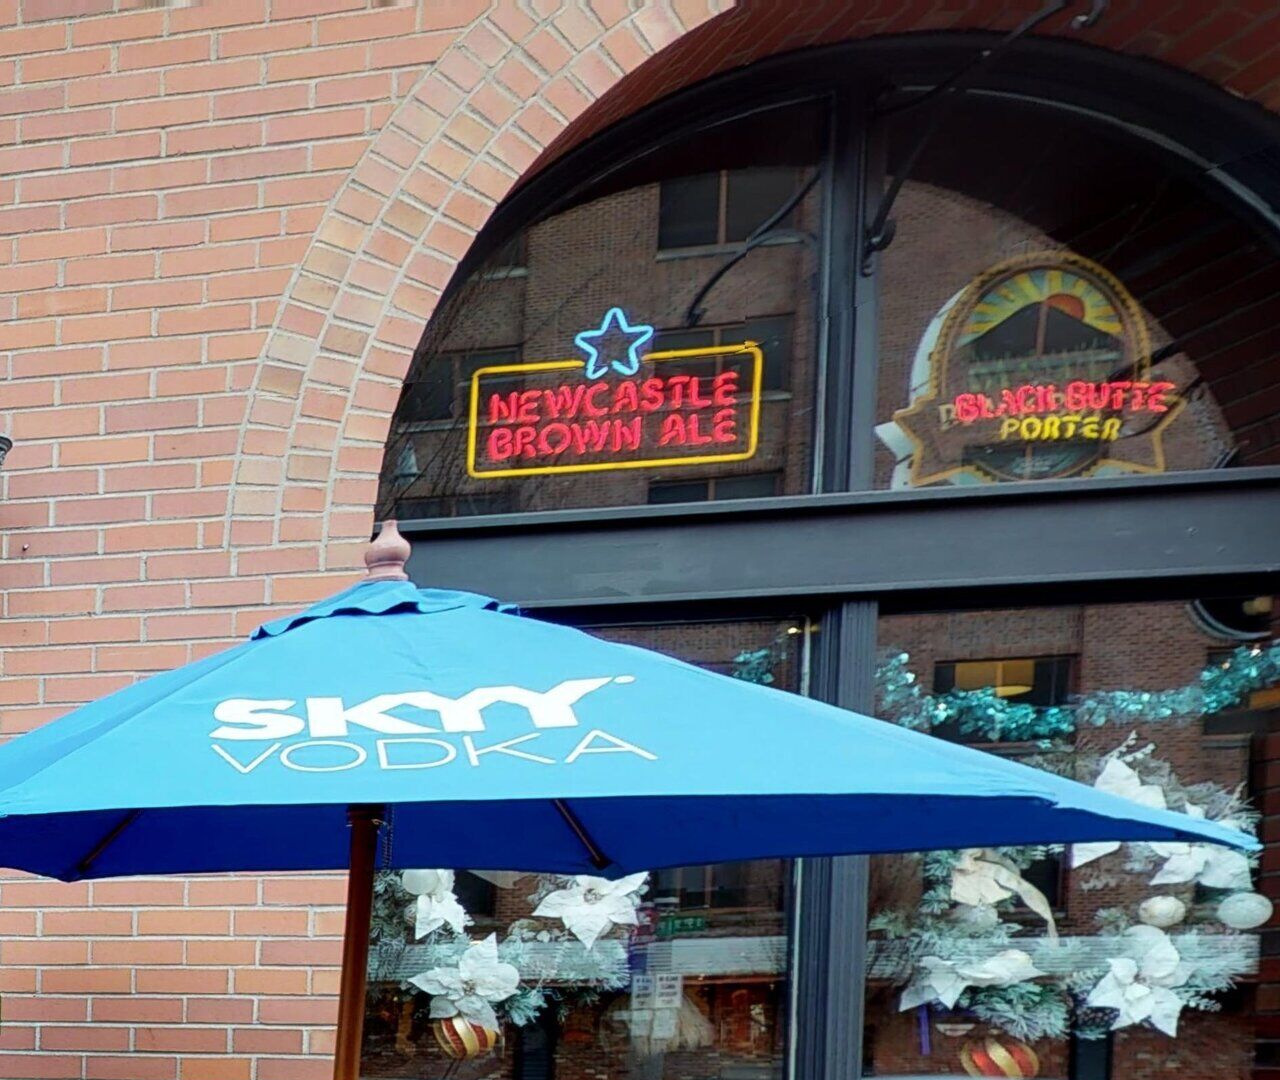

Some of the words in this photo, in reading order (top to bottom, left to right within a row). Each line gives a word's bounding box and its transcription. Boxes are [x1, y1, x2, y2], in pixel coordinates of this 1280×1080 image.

[488, 370, 739, 426] NEWCASTLE
[1064, 380, 1177, 413] BUTTE
[487, 416, 643, 462] BROWN
[657, 408, 738, 447] ALE
[999, 413, 1123, 443] PORTER
[208, 675, 636, 740] SKYY
[210, 729, 659, 774] VODKA
